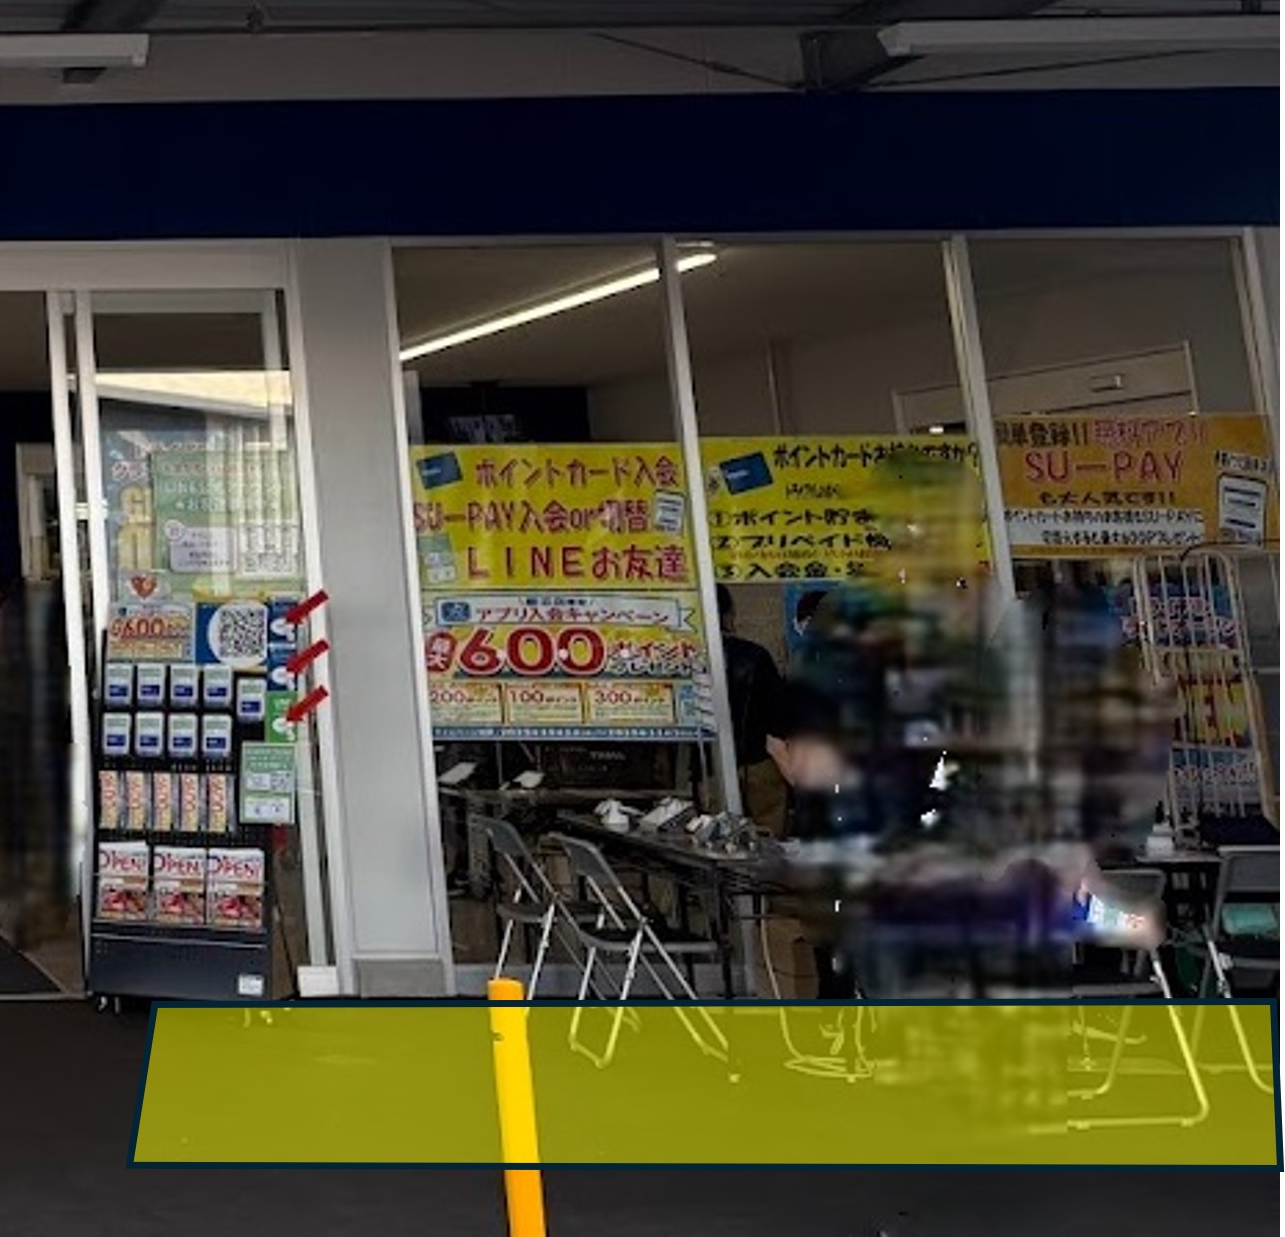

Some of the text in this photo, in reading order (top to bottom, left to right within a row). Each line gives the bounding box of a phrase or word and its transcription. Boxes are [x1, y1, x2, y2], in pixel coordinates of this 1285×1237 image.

[475, 455, 678, 488] ポイントカード入会
[460, 627, 607, 676] 600
